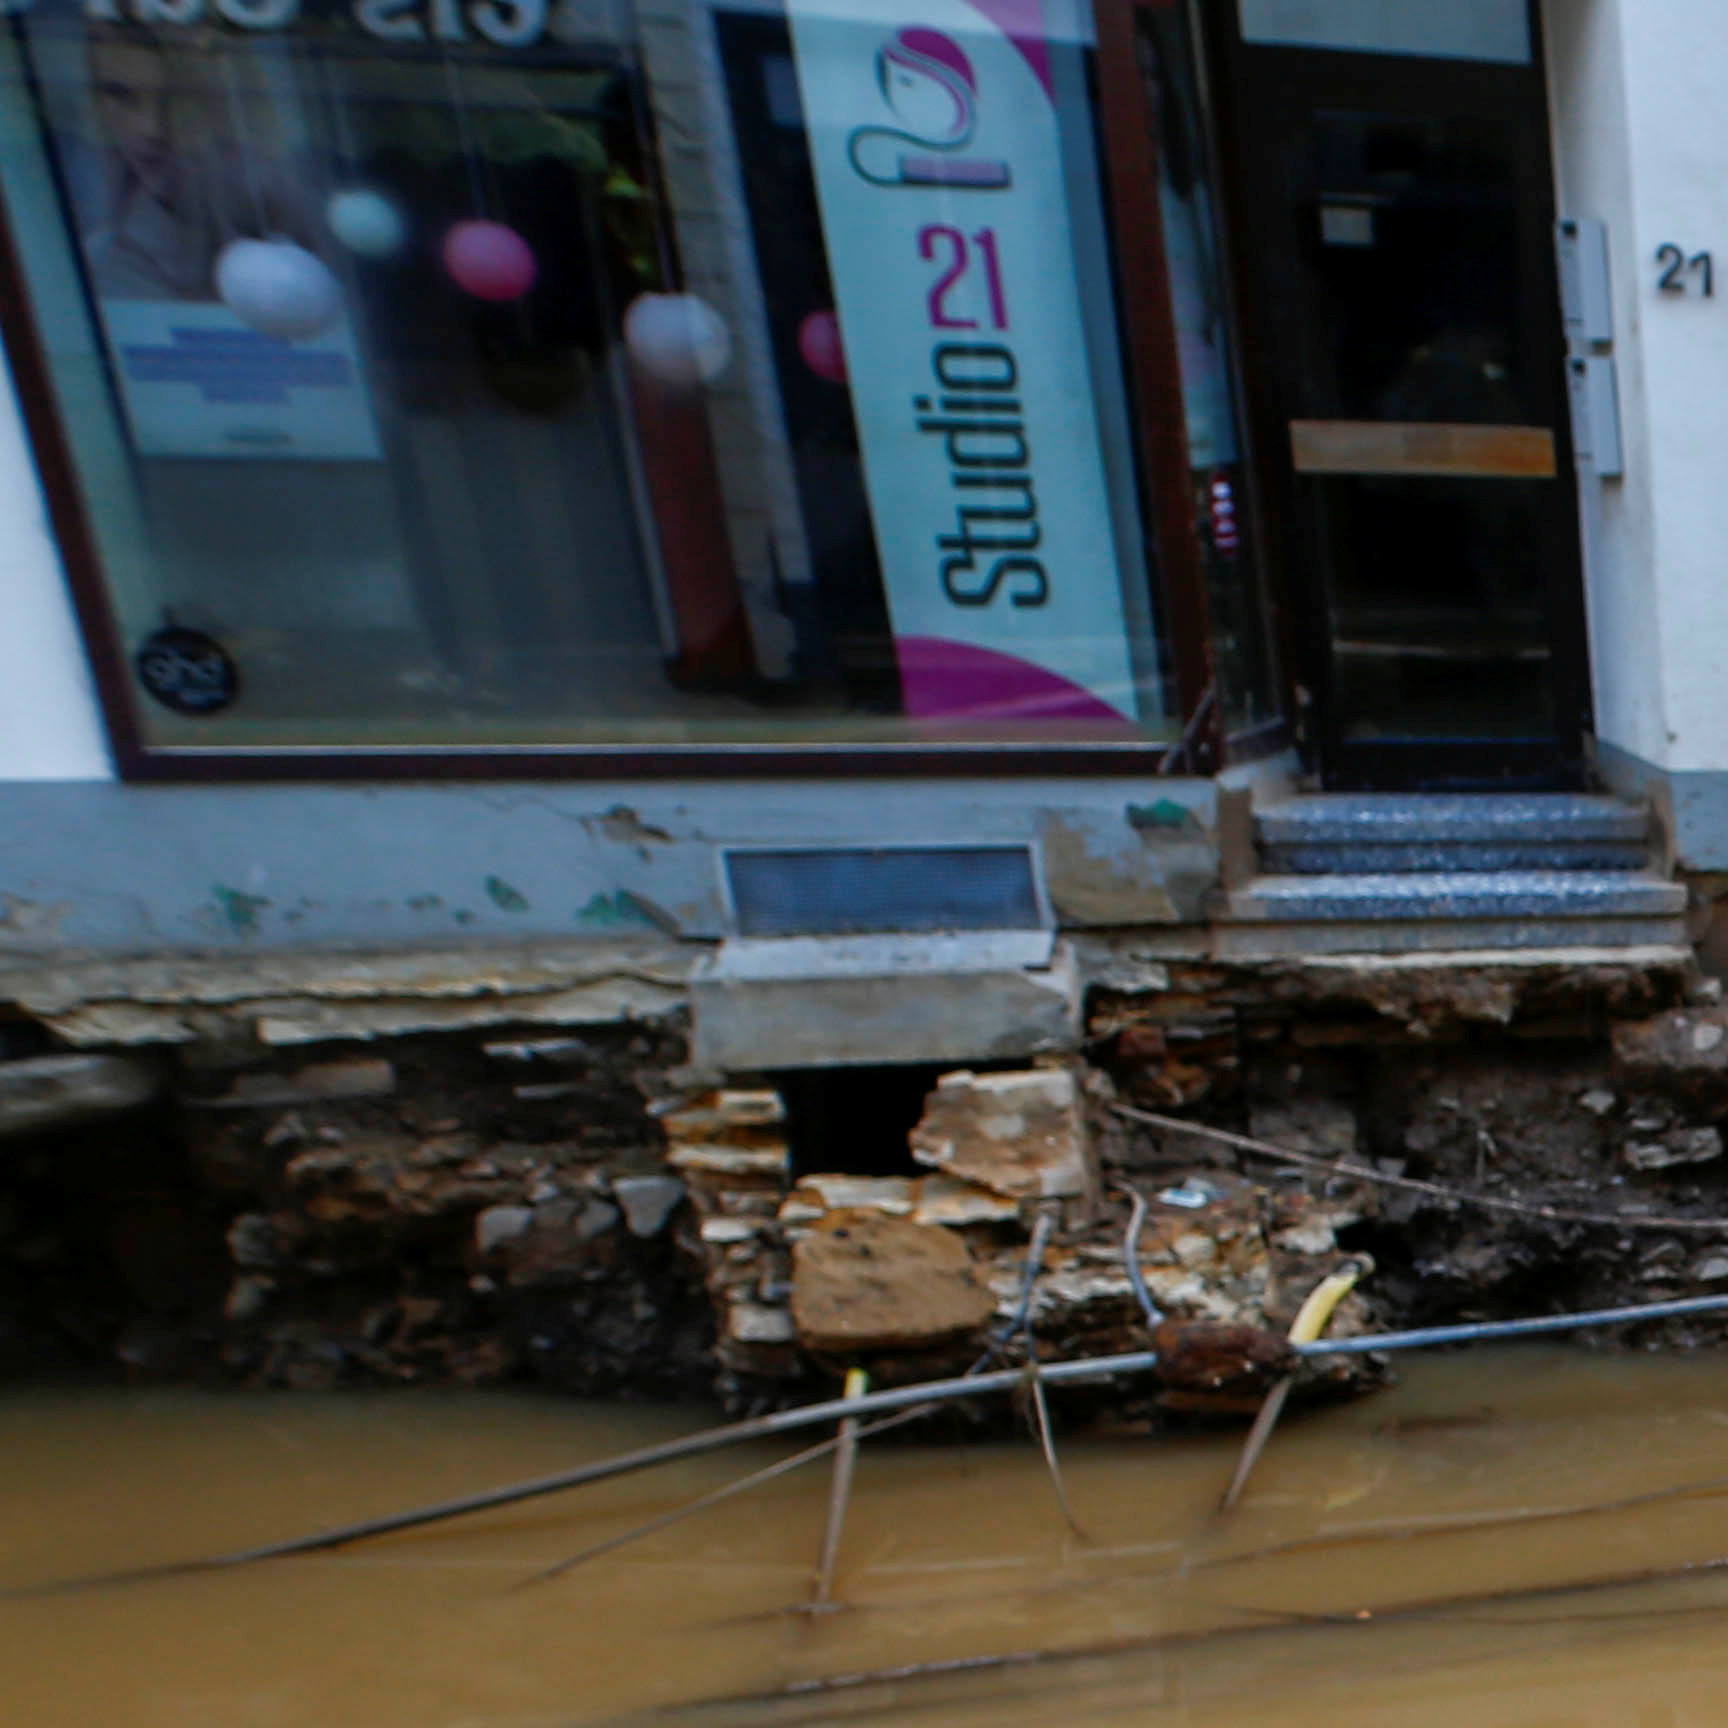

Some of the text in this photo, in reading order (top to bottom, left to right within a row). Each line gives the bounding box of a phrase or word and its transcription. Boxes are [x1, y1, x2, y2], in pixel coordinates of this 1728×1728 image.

[1655, 242, 1713, 299] 21
[913, 223, 1049, 609] Studio 21
